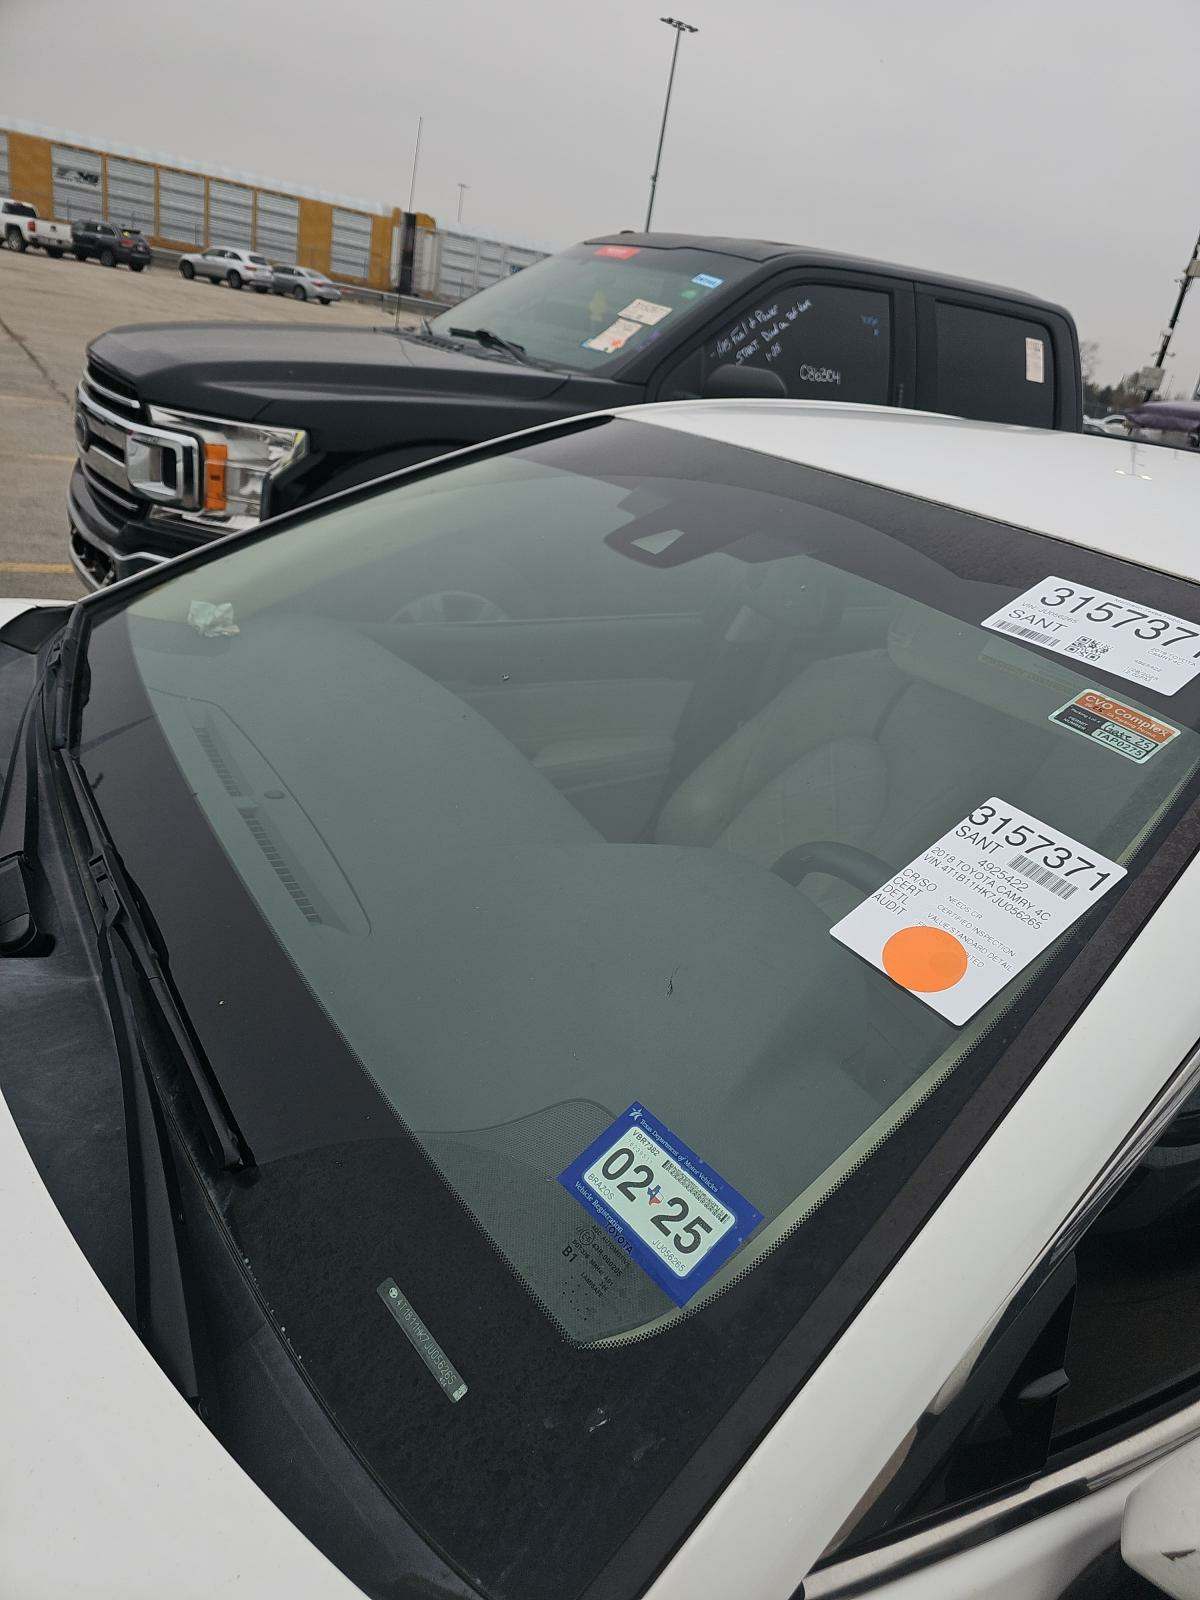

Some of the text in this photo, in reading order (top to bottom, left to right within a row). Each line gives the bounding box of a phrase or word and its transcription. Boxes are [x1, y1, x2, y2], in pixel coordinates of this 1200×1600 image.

[1008, 609, 1069, 633] SANT
[1085, 695, 1170, 738] CVO Complex
[1097, 731, 1143, 757] TAP0275
[955, 825, 1004, 854] SANT
[968, 805, 1111, 891] 3157371
[893, 876, 924, 896] CERT
[931, 847, 1051, 920] 2018 TOYOTA CAMRY 4C
[977, 858, 1029, 892] 4925422
[871, 893, 907, 915] AUDIT
[882, 884, 911, 905] DETL
[937, 904, 972, 928] CERTIFIED
[971, 926, 1016, 957] INSPECTION
[587, 1173, 615, 1200] BRAZOS
[602, 1148, 713, 1254] 02 25
[575, 1181, 593, 1201] Vehicle
[591, 1199, 623, 1234] Registration
[605, 1221, 633, 1255] TOYOTA
